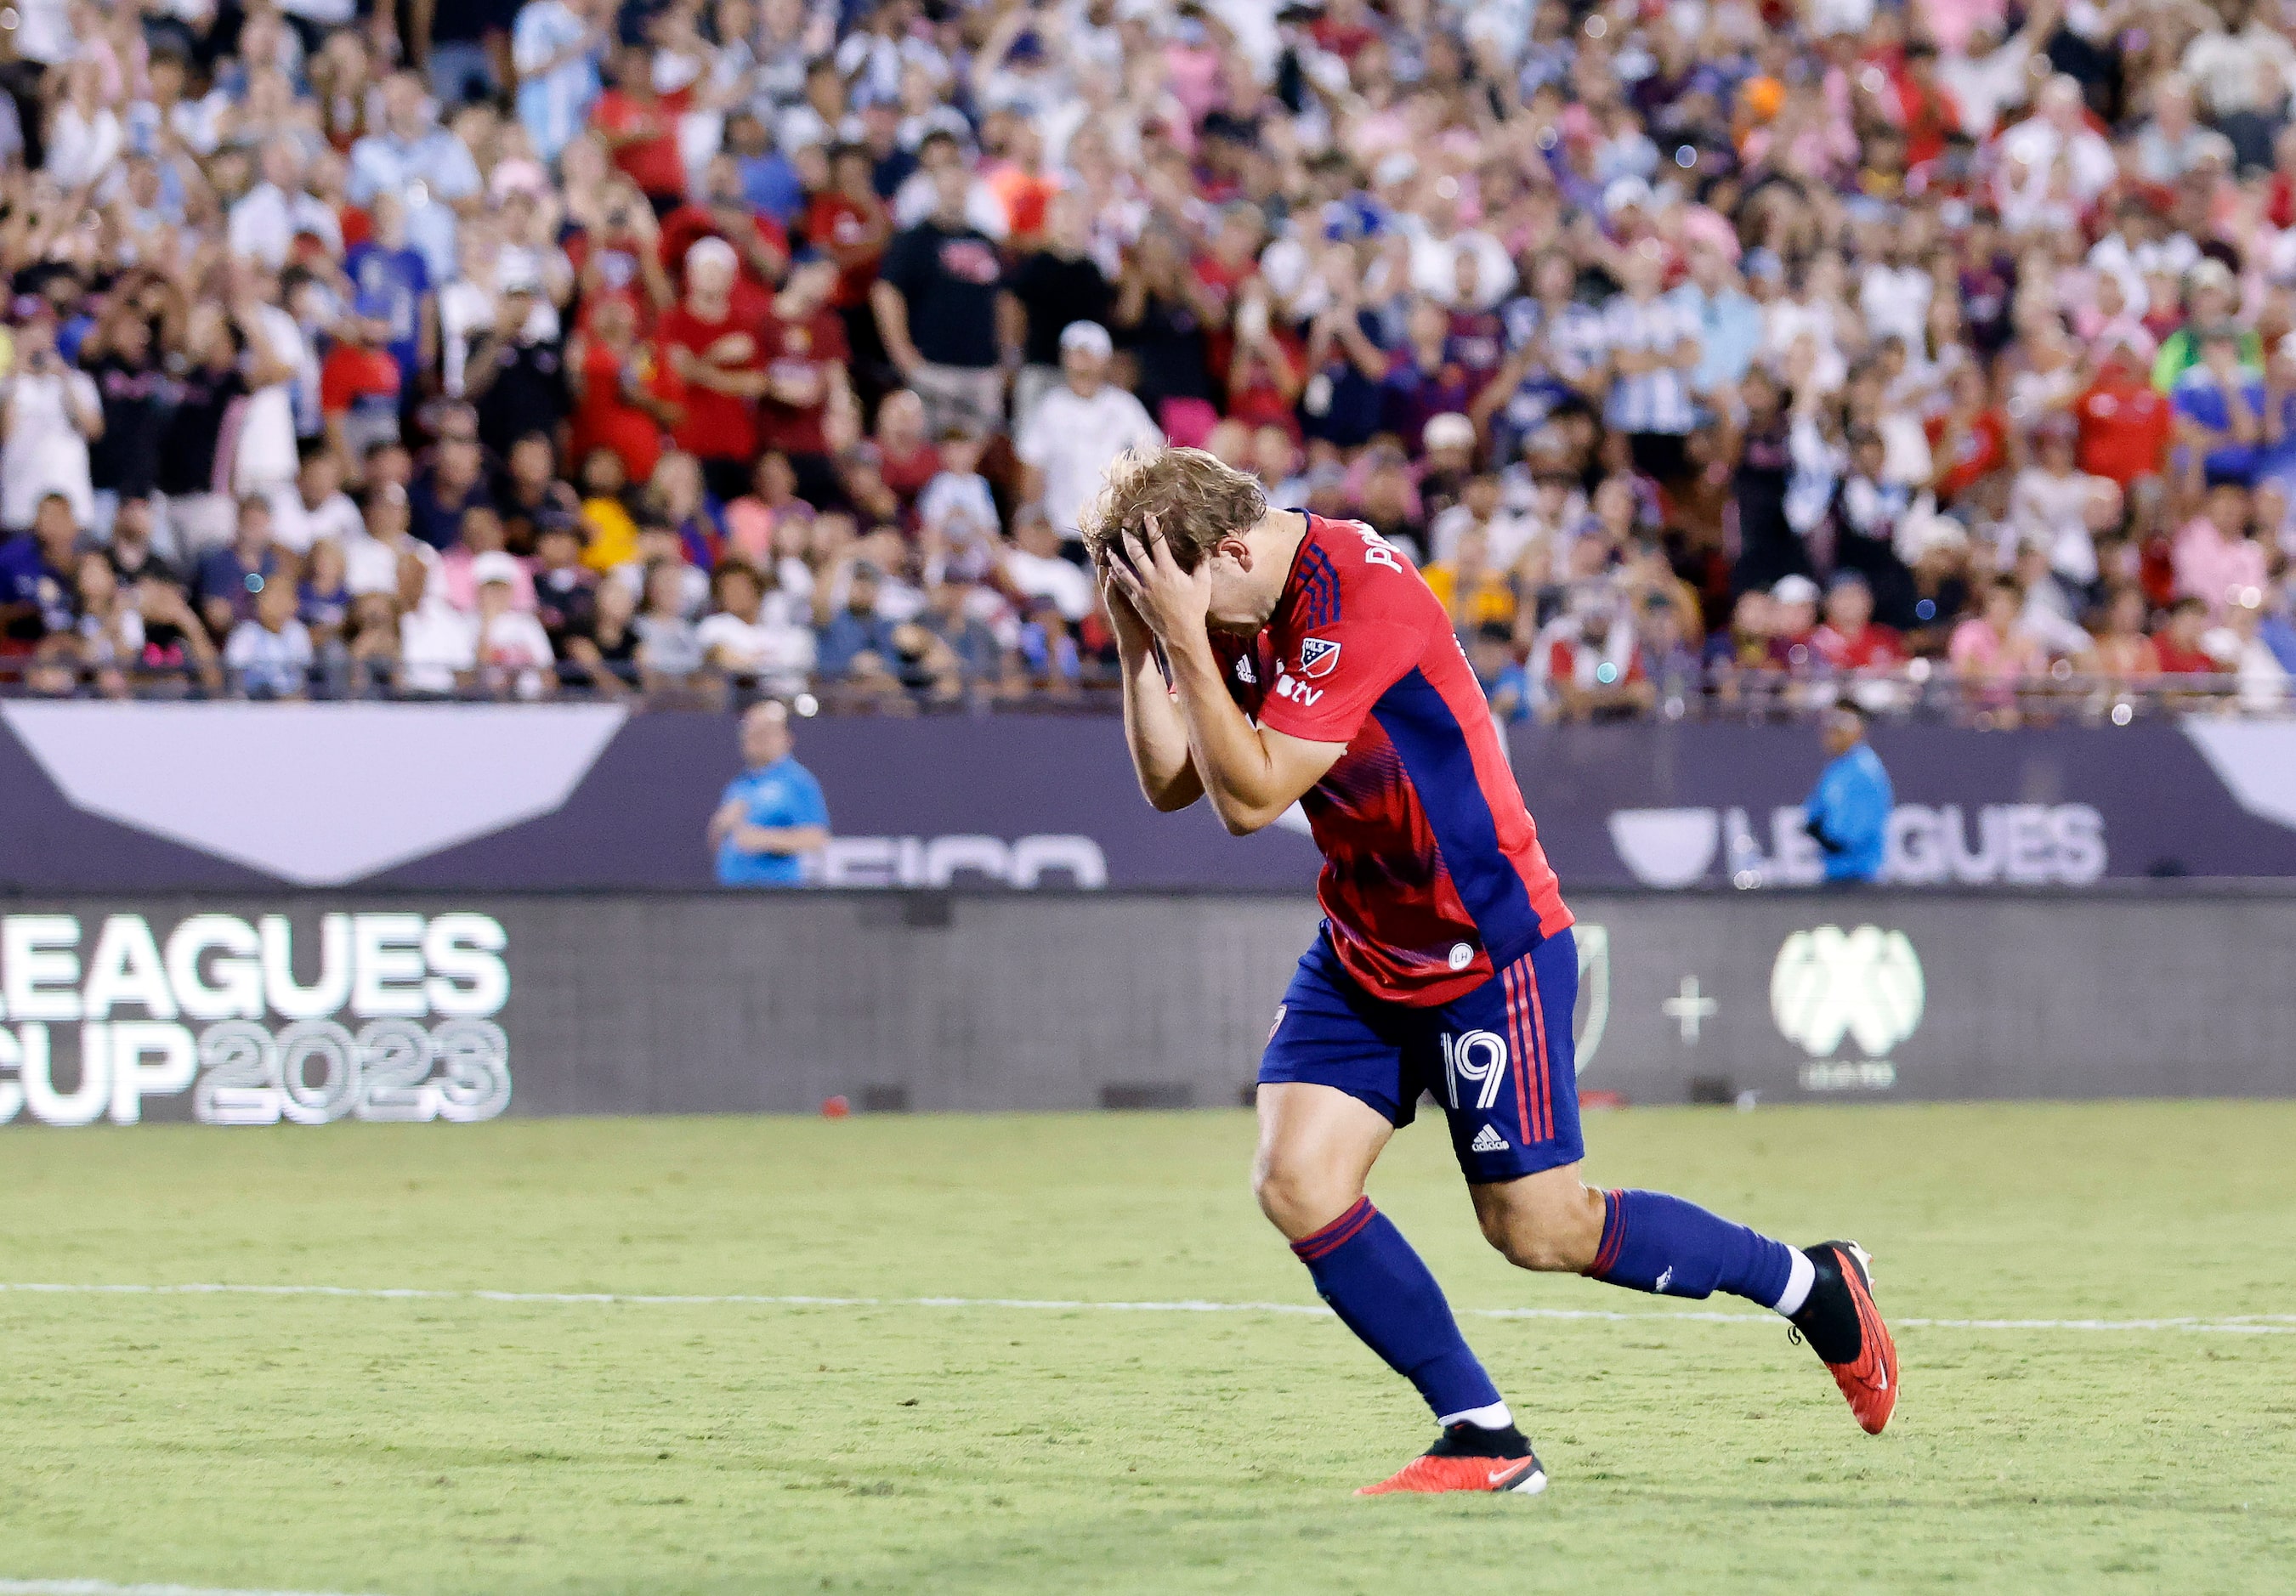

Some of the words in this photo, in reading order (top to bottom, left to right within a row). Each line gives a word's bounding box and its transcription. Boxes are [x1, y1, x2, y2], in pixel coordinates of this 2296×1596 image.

[1305, 641, 1325, 654] MLS
[1291, 680, 1324, 707] tv
[1724, 802, 2109, 886] LEGUES
[0, 912, 512, 1020] EAGUES
[1454, 951, 1468, 963] LH
[0, 1020, 199, 1126] UP
[194, 1018, 512, 1124] 2023
[1440, 1028, 1508, 1109] 19
[1471, 1140, 1510, 1152] adidas
